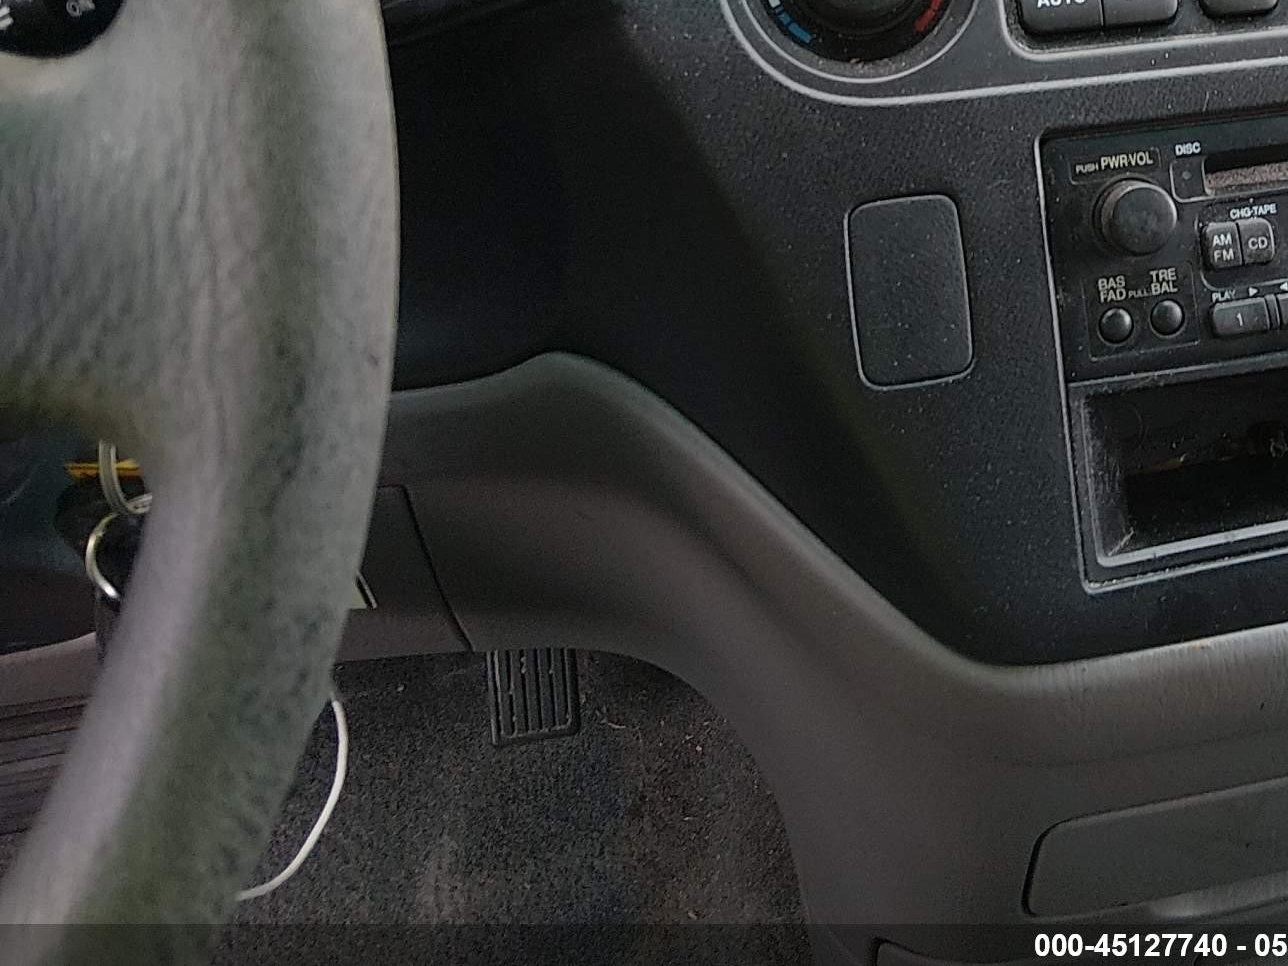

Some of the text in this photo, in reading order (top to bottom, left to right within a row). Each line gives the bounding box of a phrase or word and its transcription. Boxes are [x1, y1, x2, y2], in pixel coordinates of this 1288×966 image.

[1175, 142, 1201, 156] DISC
[1075, 162, 1099, 174] PUSH
[1212, 232, 1232, 247] AM
[1248, 236, 1268, 249] CD
[1213, 248, 1234, 262] FM
[1149, 267, 1177, 283] TRE
[1098, 275, 1126, 291] BAS
[1151, 281, 1178, 295] BAL
[1099, 288, 1126, 303] FAD
[1212, 290, 1236, 303] PLAY
[1236, 313, 1244, 326] 1
